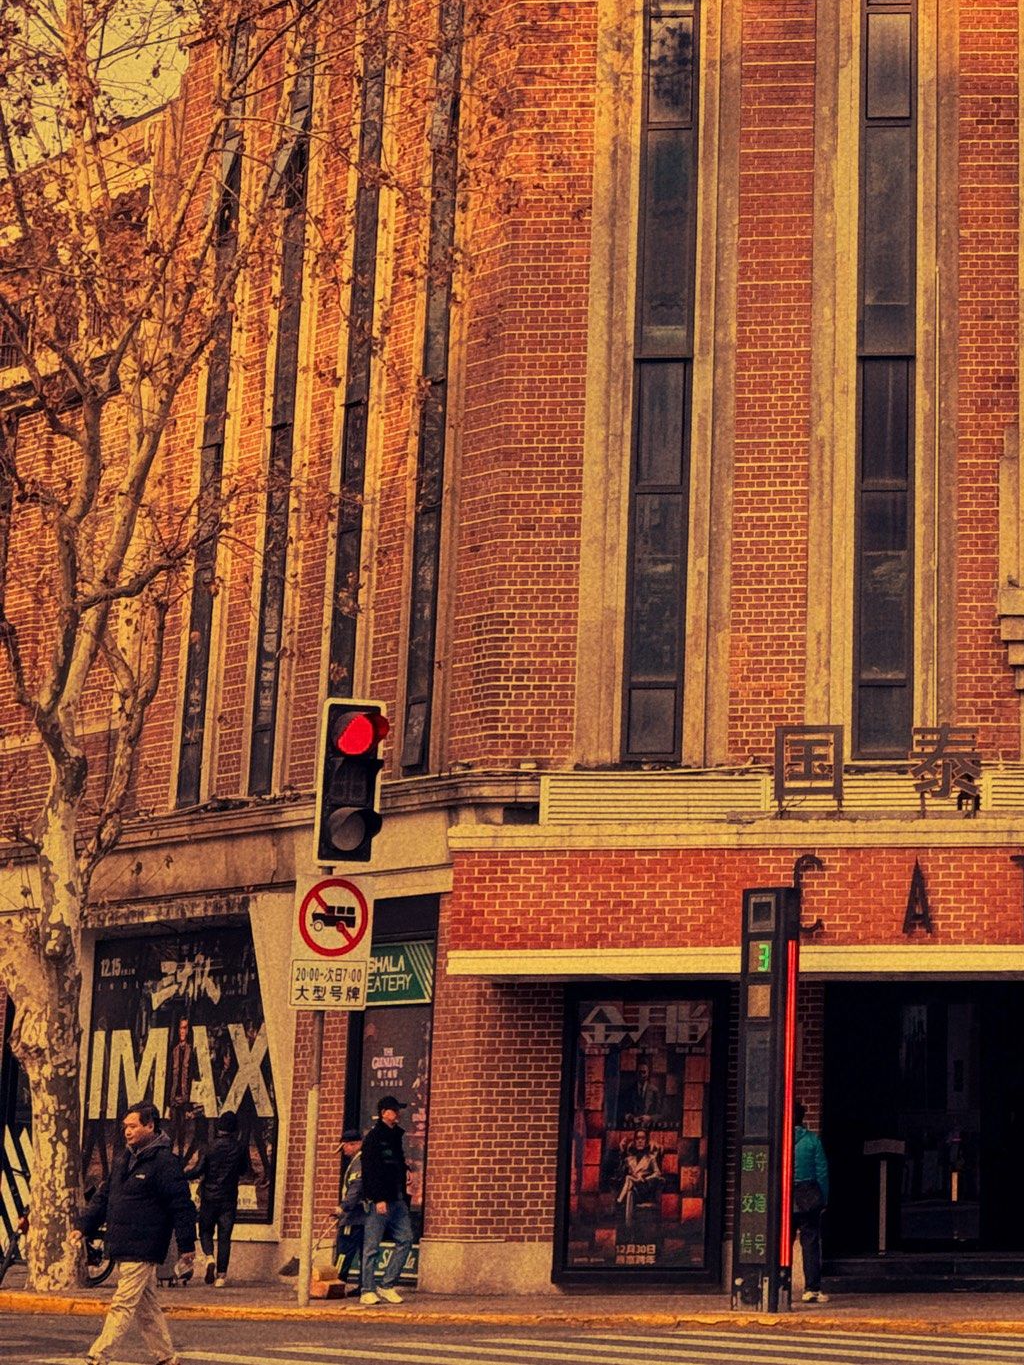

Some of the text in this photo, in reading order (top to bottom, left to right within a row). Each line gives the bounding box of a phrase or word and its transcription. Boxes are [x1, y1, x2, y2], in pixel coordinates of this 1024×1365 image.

[758, 944, 769, 972] 3
[295, 985, 361, 1001] 大型号牌
[367, 974, 413, 992] EATERY
[741, 1233, 766, 1256] 信号
